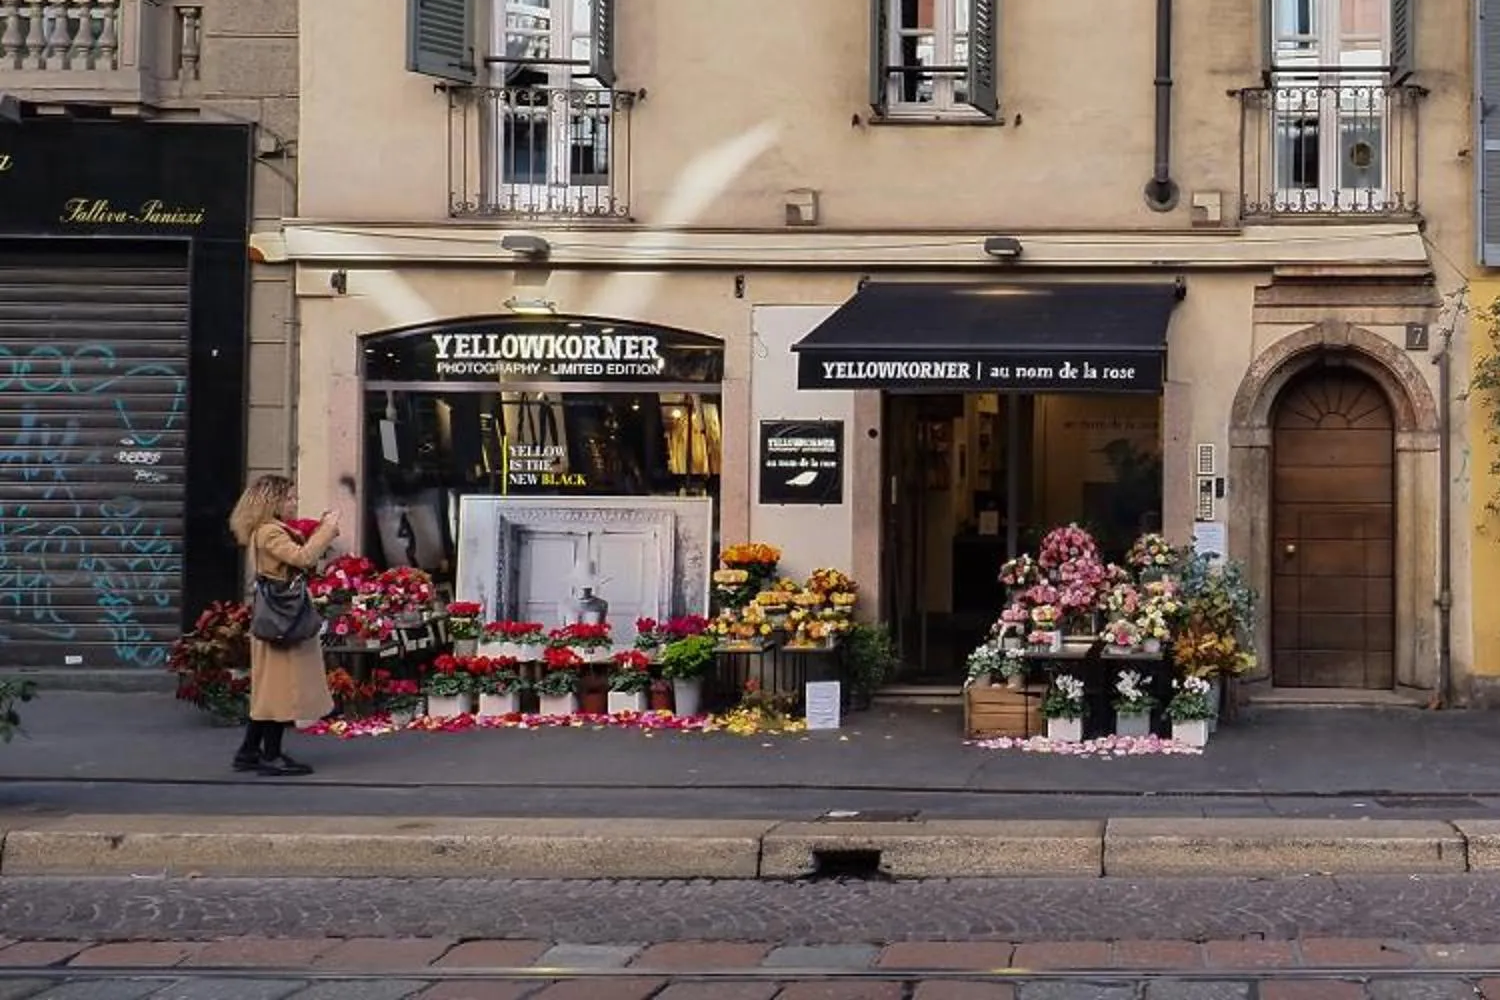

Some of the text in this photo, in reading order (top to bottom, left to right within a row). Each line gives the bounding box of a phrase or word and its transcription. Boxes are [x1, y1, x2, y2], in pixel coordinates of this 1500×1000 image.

[1412, 327, 1424, 346] 7
[431, 333, 660, 360] YELLOWKORNER
[436, 361, 663, 376] PHOTOGRAPHY LIMITED EDITION
[822, 361, 1136, 380] YELLOWKORNER au nom de la rose
[508, 445, 565, 457] YELLOW
[509, 459, 553, 471] IS THE
[508, 472, 587, 486] NEW BLACK
